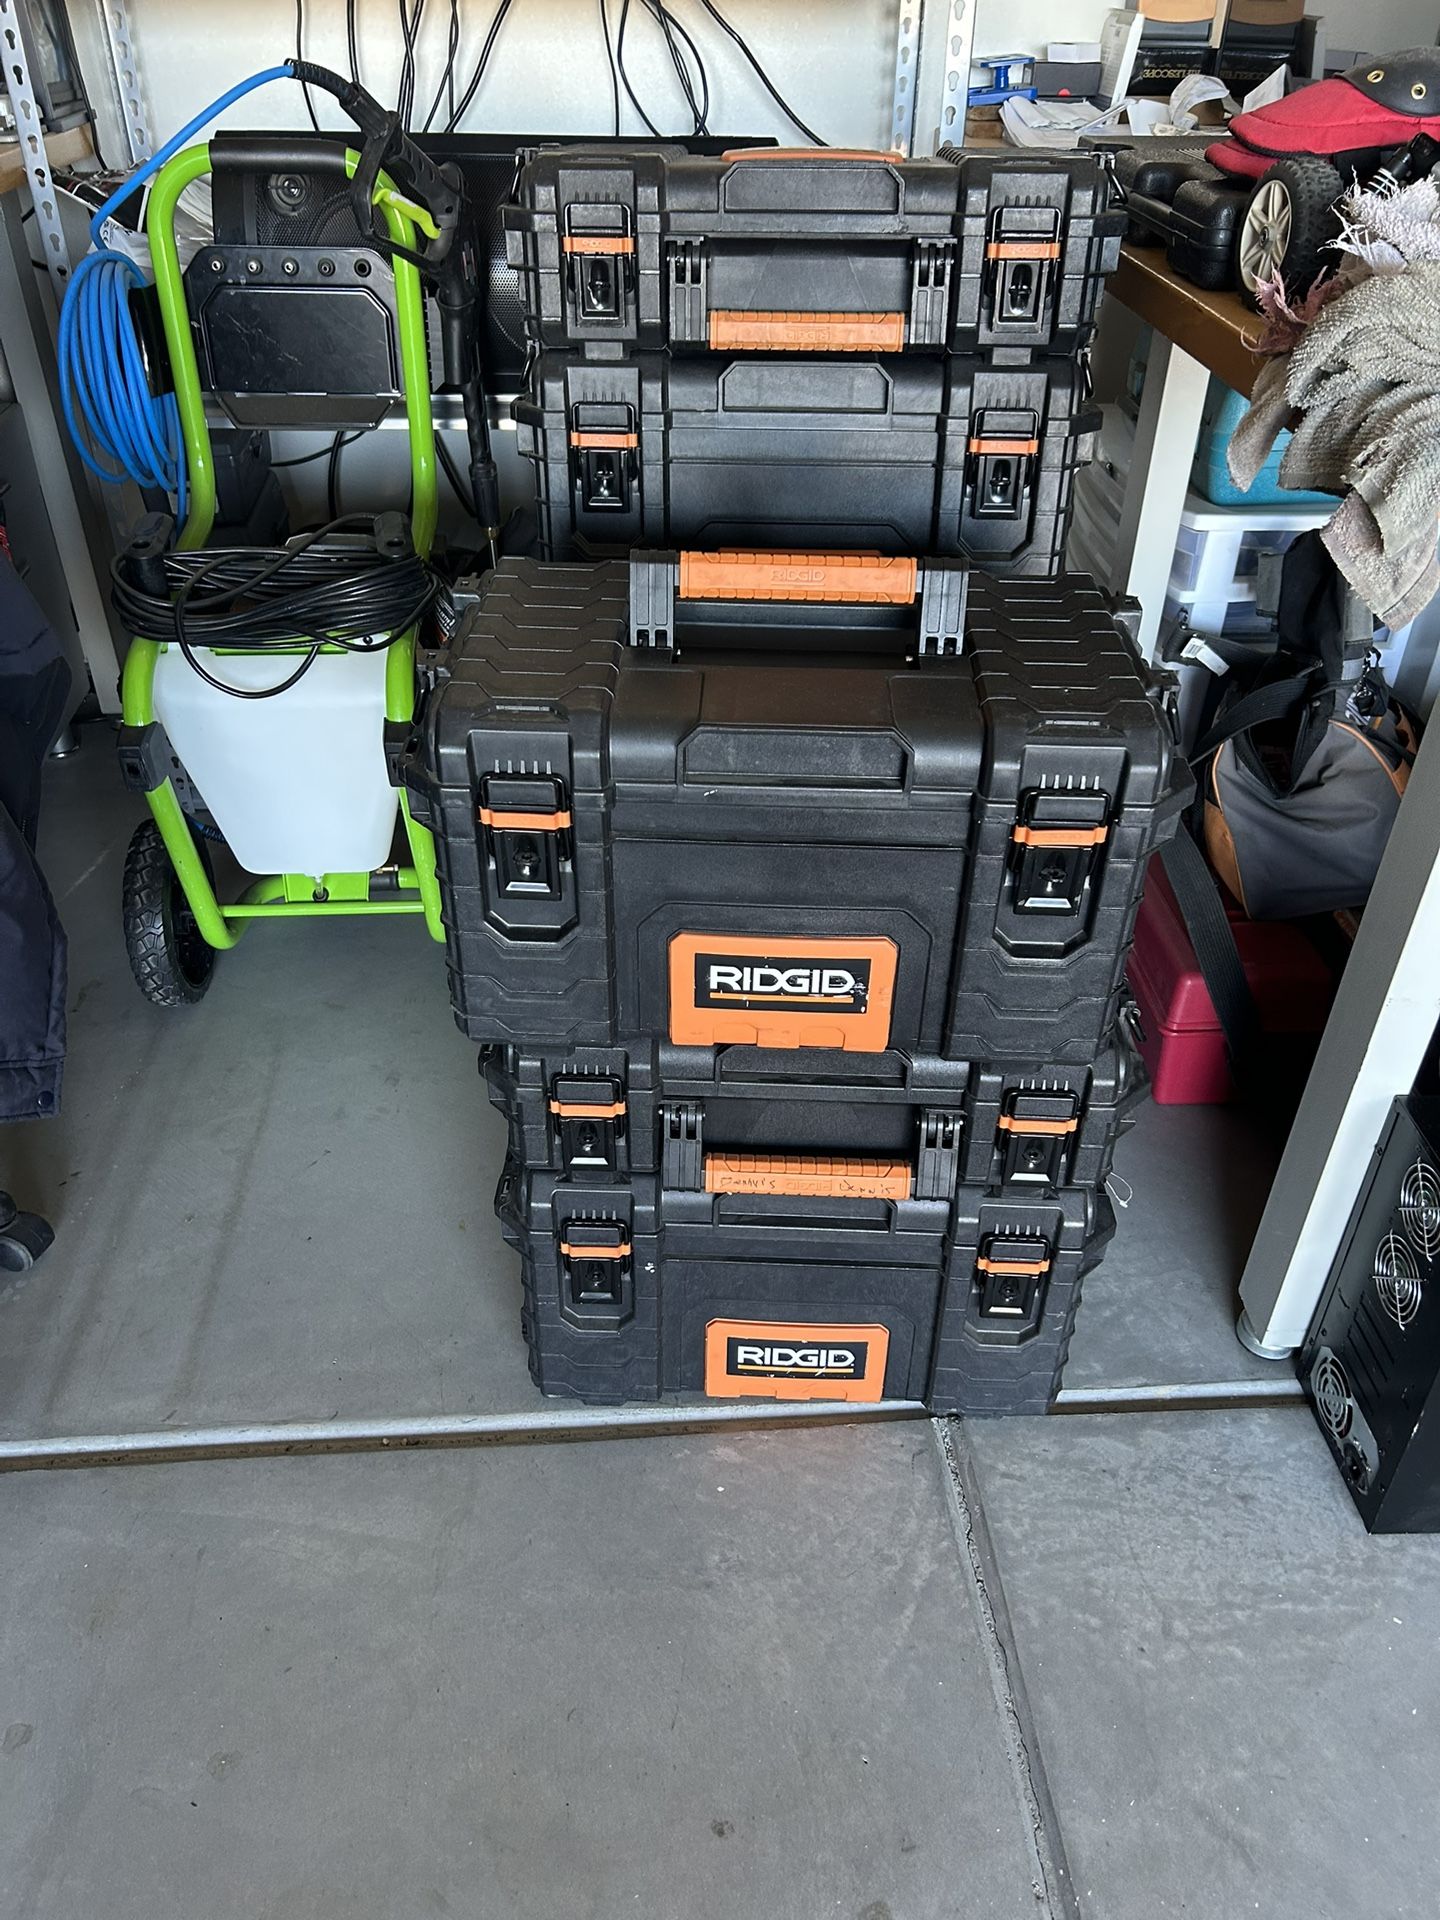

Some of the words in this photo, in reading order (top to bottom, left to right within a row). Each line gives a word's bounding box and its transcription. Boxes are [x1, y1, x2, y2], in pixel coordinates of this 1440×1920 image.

[771, 569, 825, 582] RIDGID
[709, 965, 856, 994] RIDGID
[737, 1345, 856, 1367] RIDGID
